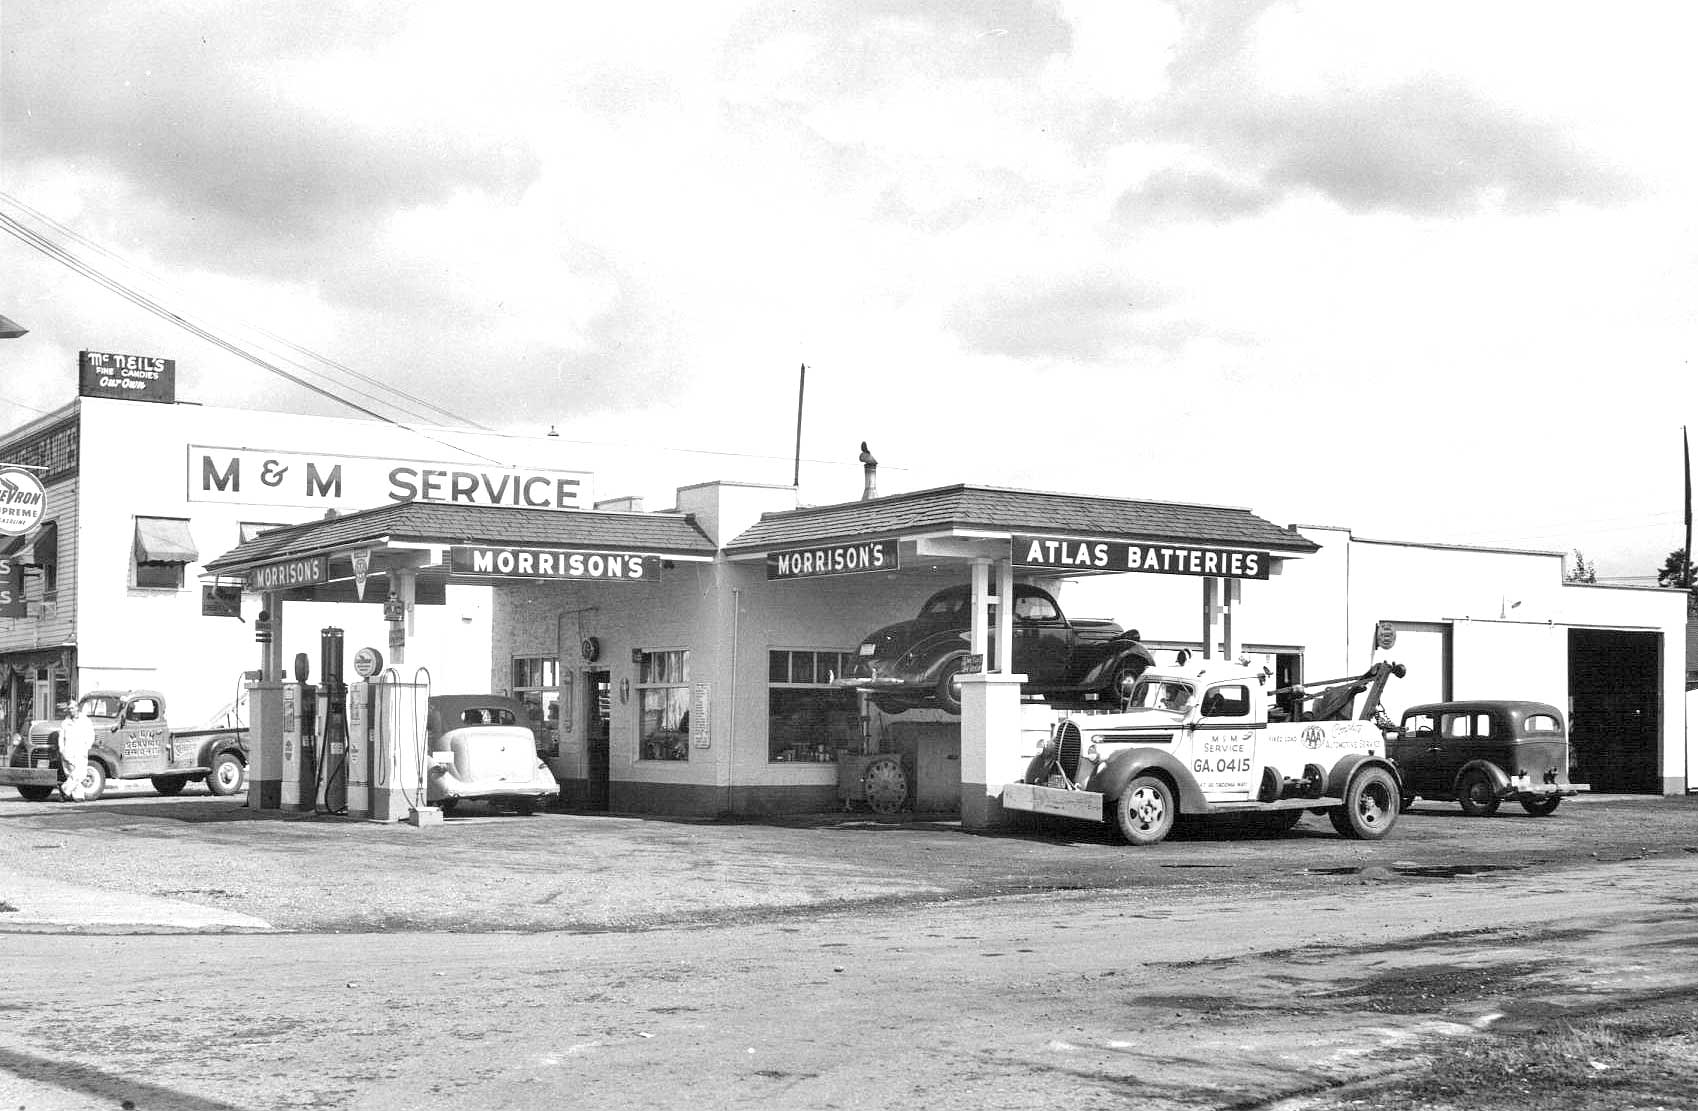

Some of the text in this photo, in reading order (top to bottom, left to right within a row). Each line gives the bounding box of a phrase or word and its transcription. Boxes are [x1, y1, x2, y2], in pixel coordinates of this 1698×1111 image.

[96, 366, 159, 379] FINE CANDIES
[0, 488, 42, 505] EVRON
[203, 455, 580, 509] M & M SERVICE
[473, 550, 643, 578] MORRISON'S
[778, 543, 884, 575] MORRISON'S
[1026, 540, 1259, 575] ATLAS BATTERIES
[257, 558, 319, 588] MORRISON'S
[1204, 742, 1244, 752] SERVICE
